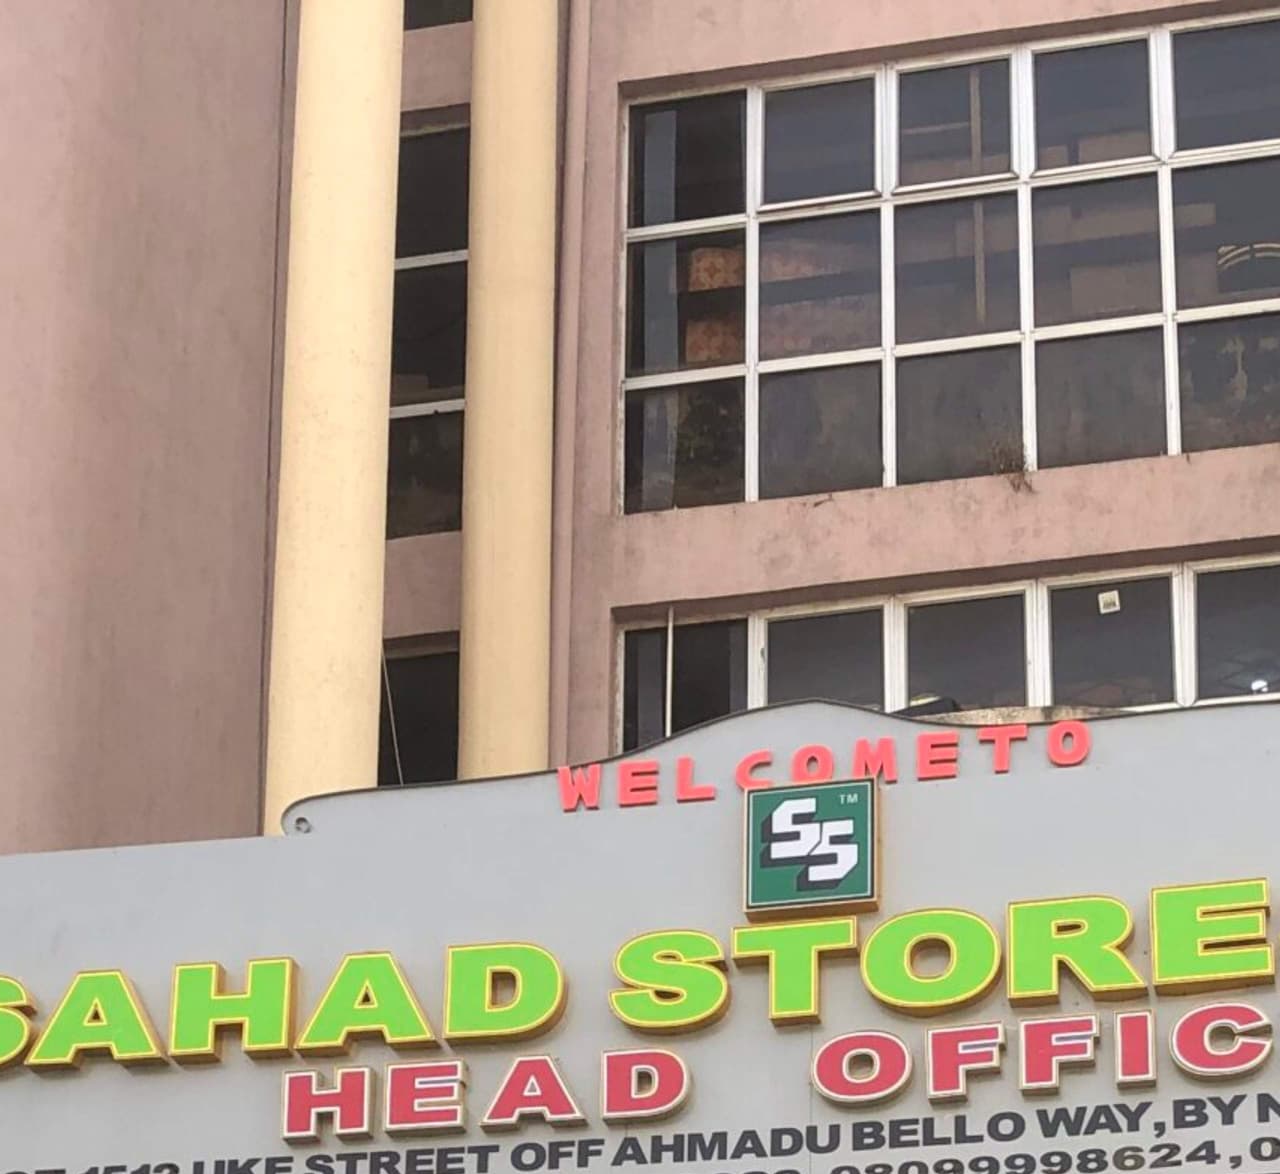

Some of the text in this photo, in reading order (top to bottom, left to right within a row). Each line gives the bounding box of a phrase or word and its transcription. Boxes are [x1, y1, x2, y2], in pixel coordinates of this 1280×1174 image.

[282, 1048, 692, 1142] HEAD
[510, 1138, 605, 1171] OFF
[612, 1123, 841, 1166] AHMADU
[852, 1111, 1026, 1152] BELLO
